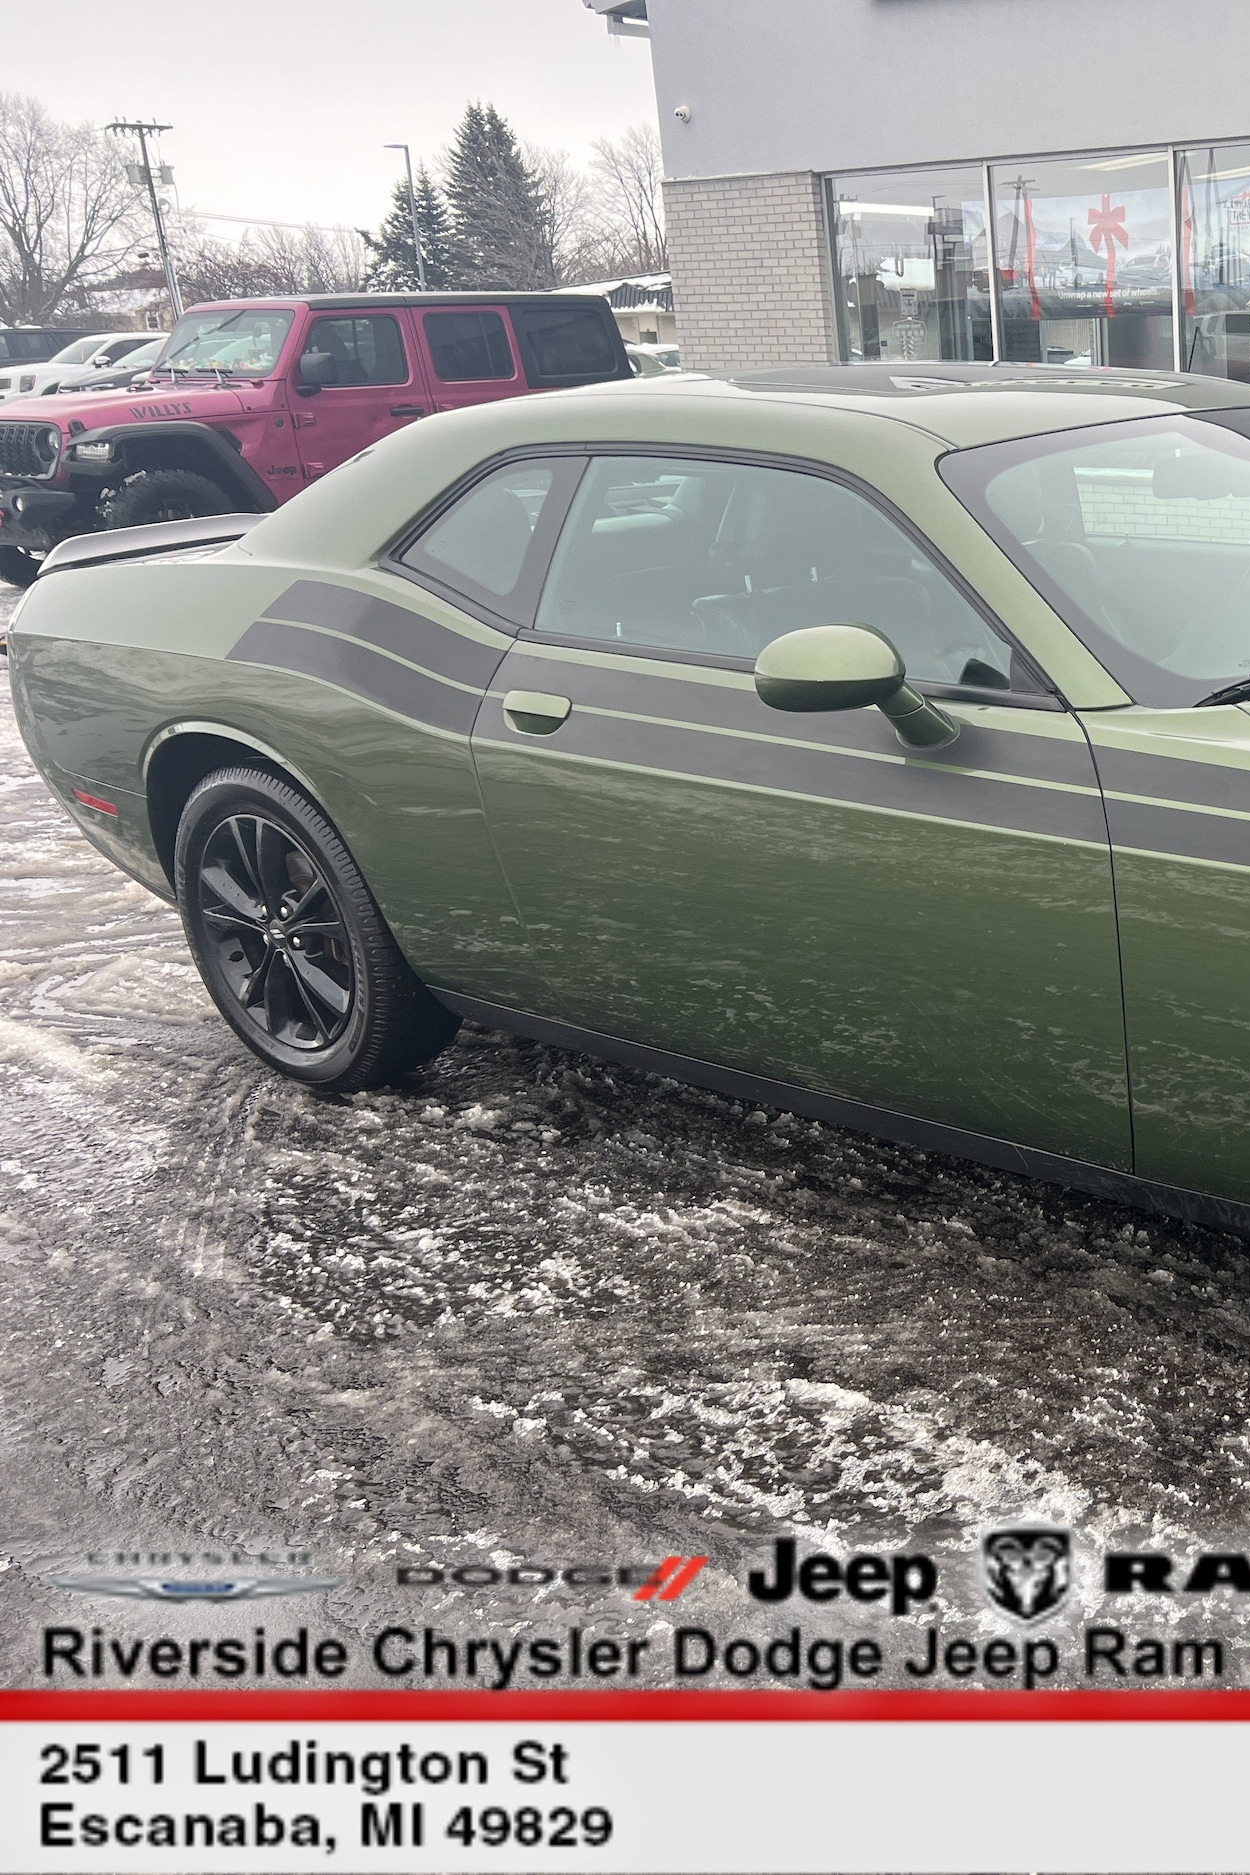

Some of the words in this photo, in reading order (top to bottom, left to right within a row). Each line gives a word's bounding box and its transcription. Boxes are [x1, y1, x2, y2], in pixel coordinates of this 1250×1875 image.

[1233, 210, 1246, 221] THE
[1058, 290, 1086, 301] Unwrap
[1109, 290, 1121, 298] set
[1121, 288, 1131, 297] of
[129, 402, 192, 419] WILLYS
[267, 465, 297, 475] Jeep
